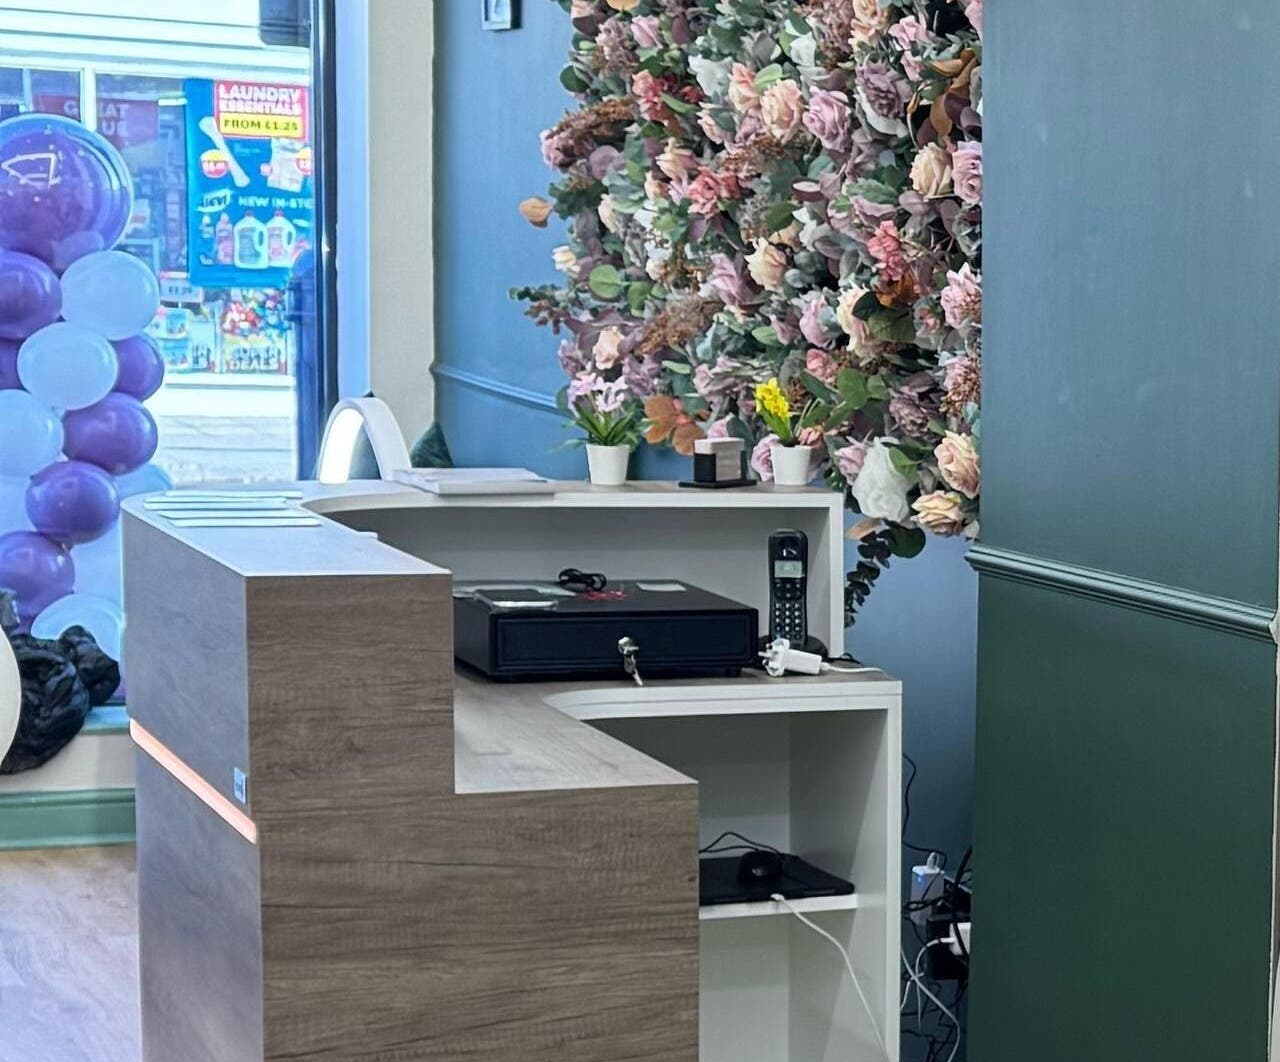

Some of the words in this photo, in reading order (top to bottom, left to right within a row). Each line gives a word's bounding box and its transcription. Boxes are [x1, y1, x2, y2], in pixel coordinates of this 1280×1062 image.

[219, 84, 302, 103] LAUNDRY
[219, 100, 302, 115] ESSENTIALS
[224, 119, 261, 129] FROM
[238, 196, 269, 207] NEW
